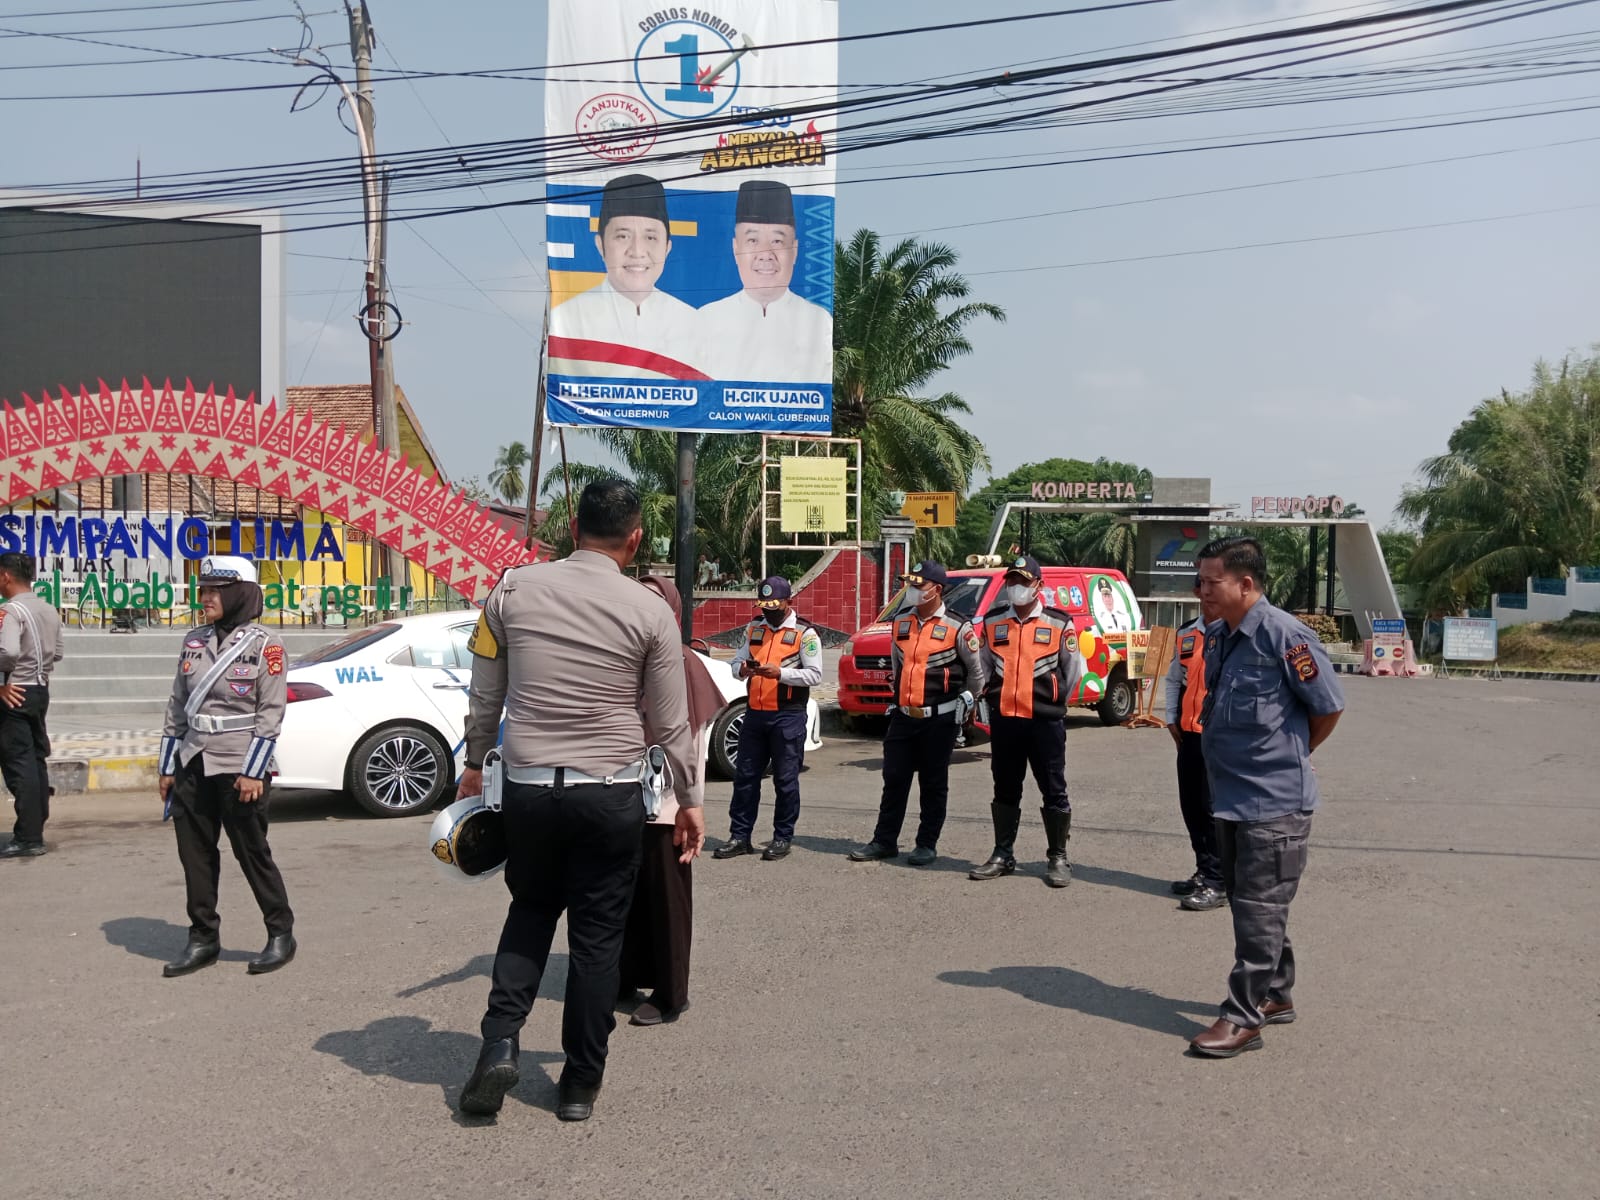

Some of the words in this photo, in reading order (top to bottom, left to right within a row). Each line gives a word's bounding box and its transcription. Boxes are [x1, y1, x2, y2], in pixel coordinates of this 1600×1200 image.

[638, 7, 688, 33] COBLOS
[691, 8, 738, 40] NOMOR
[664, 33, 714, 104] 1
[586, 99, 647, 123] LANJUTKAN
[728, 131, 799, 147] MENYALA
[561, 384, 647, 400] H.HERMAN
[650, 388, 694, 401] DERU
[725, 390, 767, 403] H.CIK
[769, 391, 820, 404] UJANG
[614, 409, 670, 419] GUBERNUR
[708, 411, 742, 421] CALON
[744, 412, 776, 422] WAKIL
[778, 413, 830, 423] GUBERNUR
[1031, 481, 1136, 499] KOMPERTA
[1251, 495, 1345, 514] PENDOPO
[0, 514, 209, 560] SIMPANG
[231, 517, 344, 561] LIMA
[1156, 560, 1195, 568] PERTAMINA
[77, 571, 175, 609] Abab
[1131, 633, 1149, 648] RAZI
[335, 666, 383, 685] WAL
